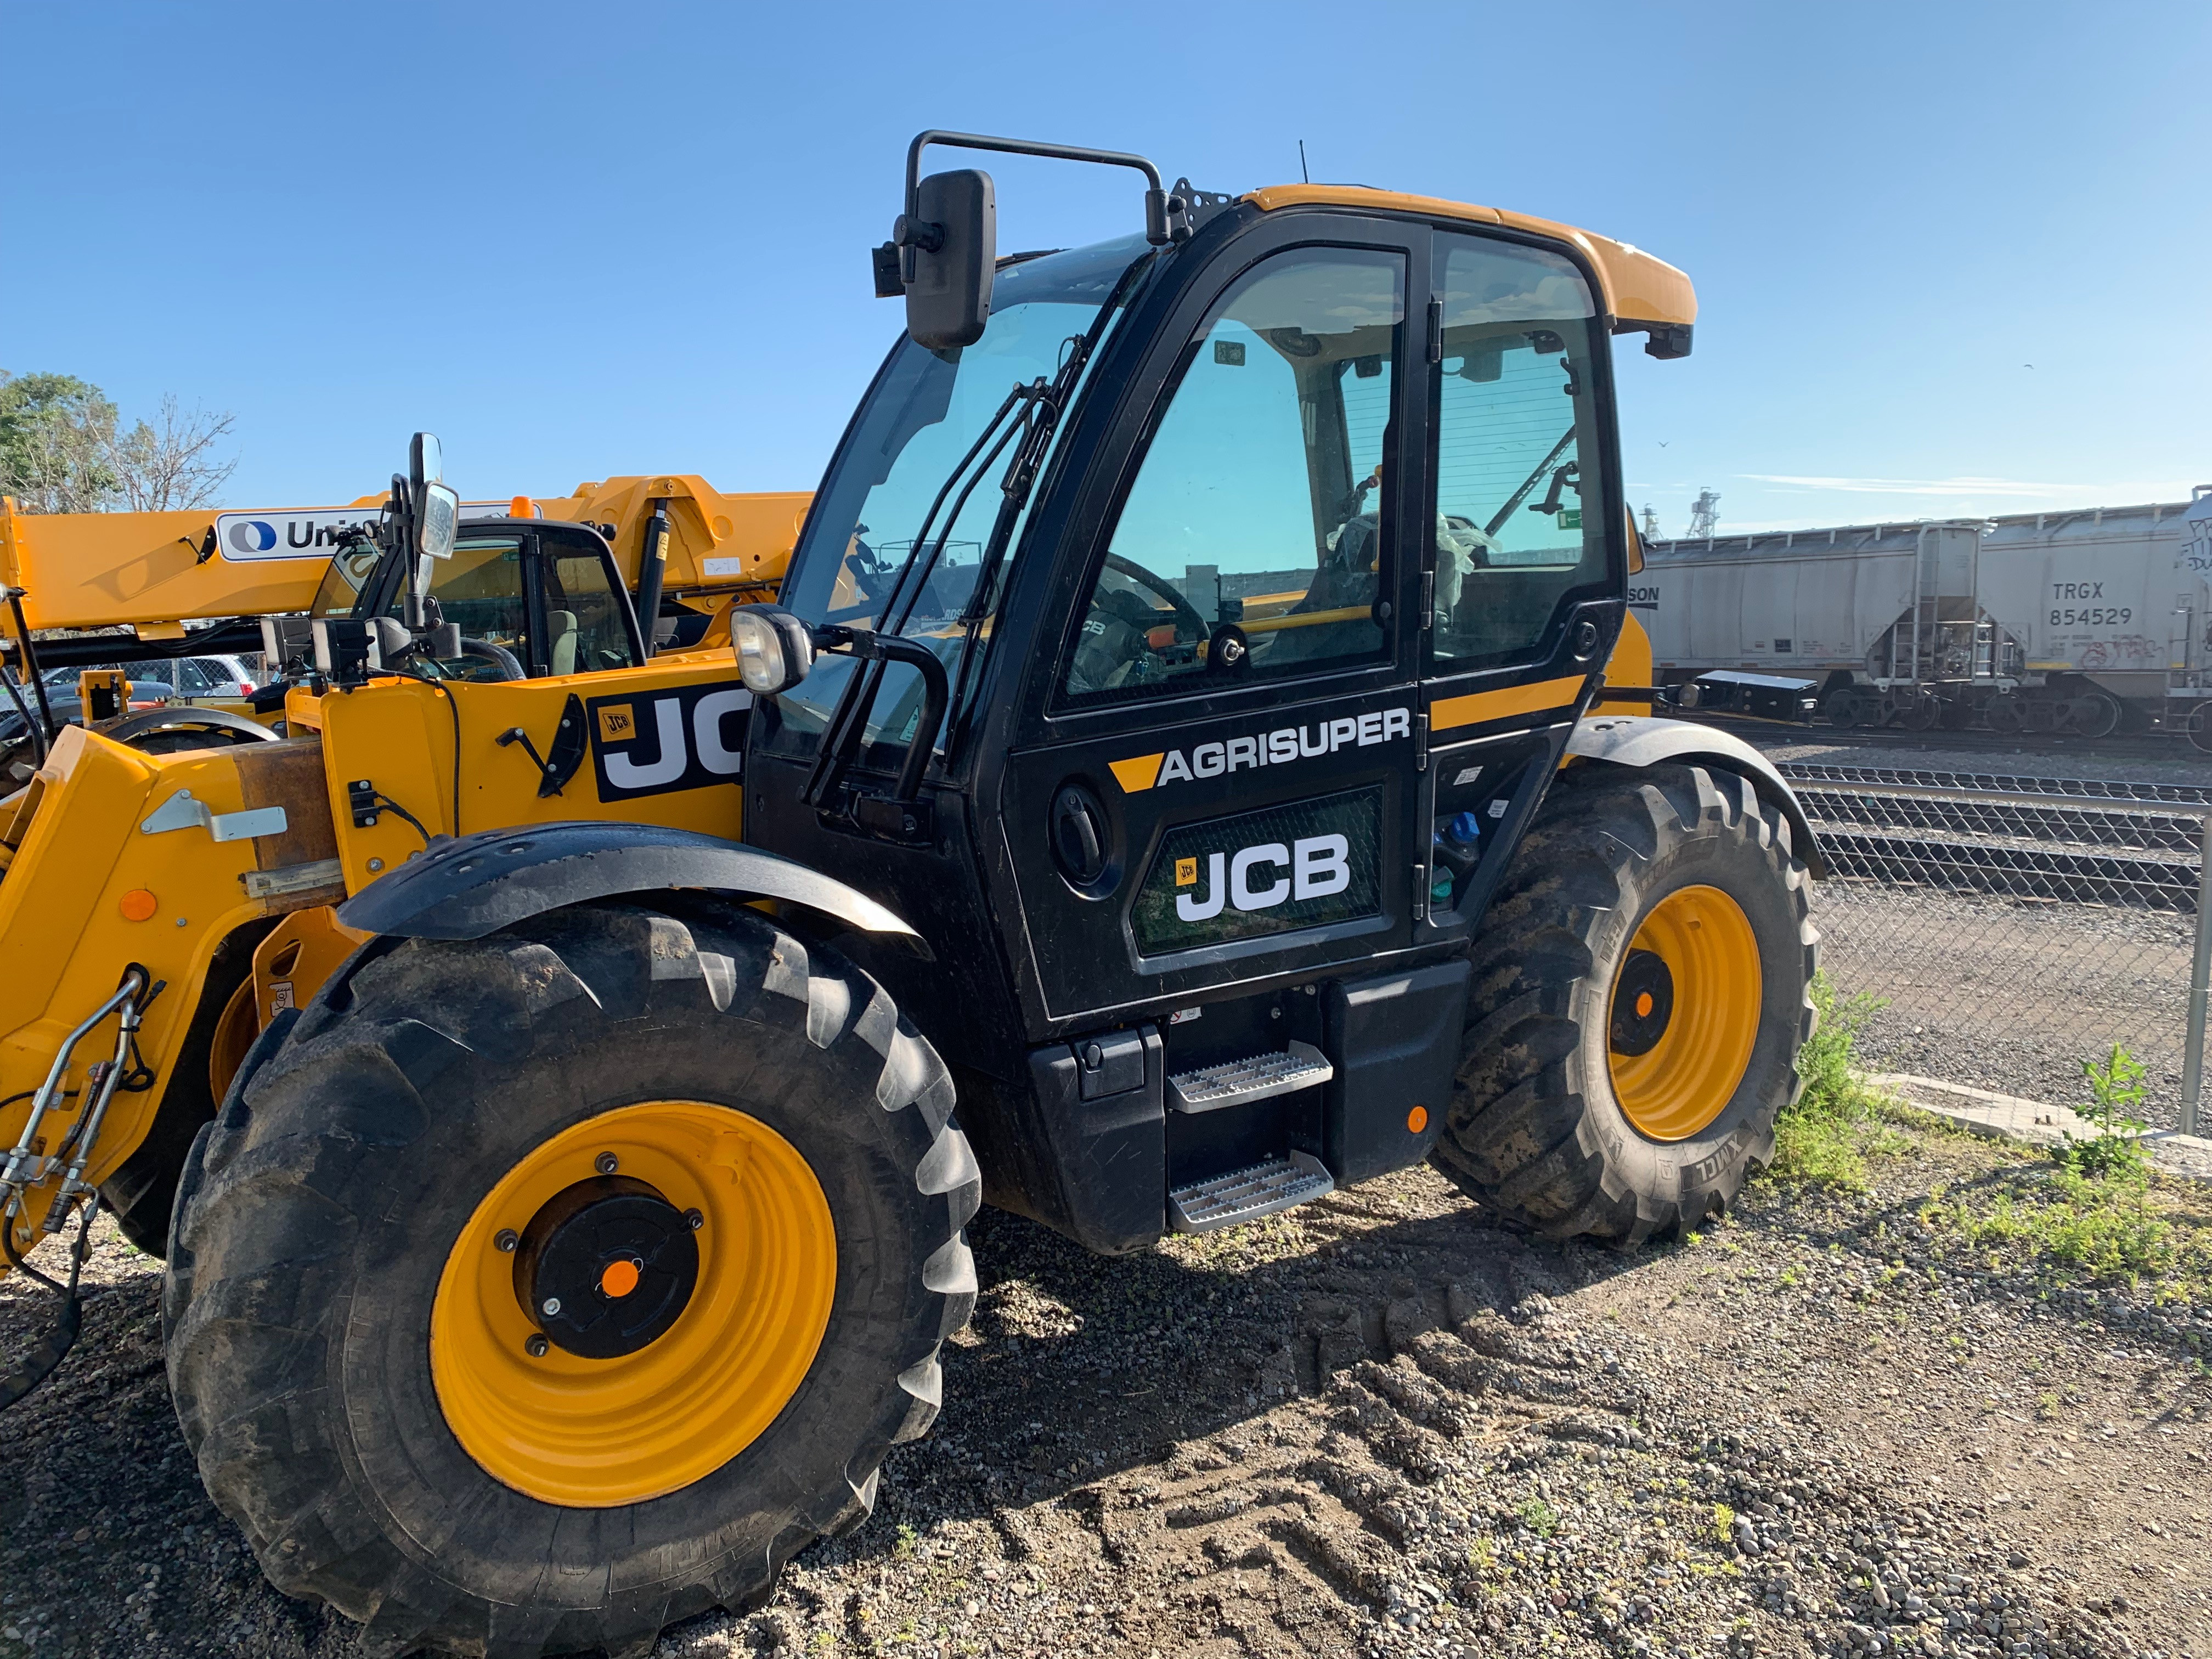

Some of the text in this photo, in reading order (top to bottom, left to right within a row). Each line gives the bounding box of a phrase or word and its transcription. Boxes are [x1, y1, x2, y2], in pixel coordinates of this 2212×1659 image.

[1628, 587, 1660, 601] SON
[2053, 582, 2103, 599] TRGX
[2050, 607, 2132, 625] 854529
[1081, 619, 1107, 635] CB
[607, 714, 629, 732] JCB
[603, 689, 754, 788] JC
[1157, 707, 1410, 787] AGRISUPER
[1176, 833, 1350, 922] JCB
[1181, 865, 1194, 878] JCB
